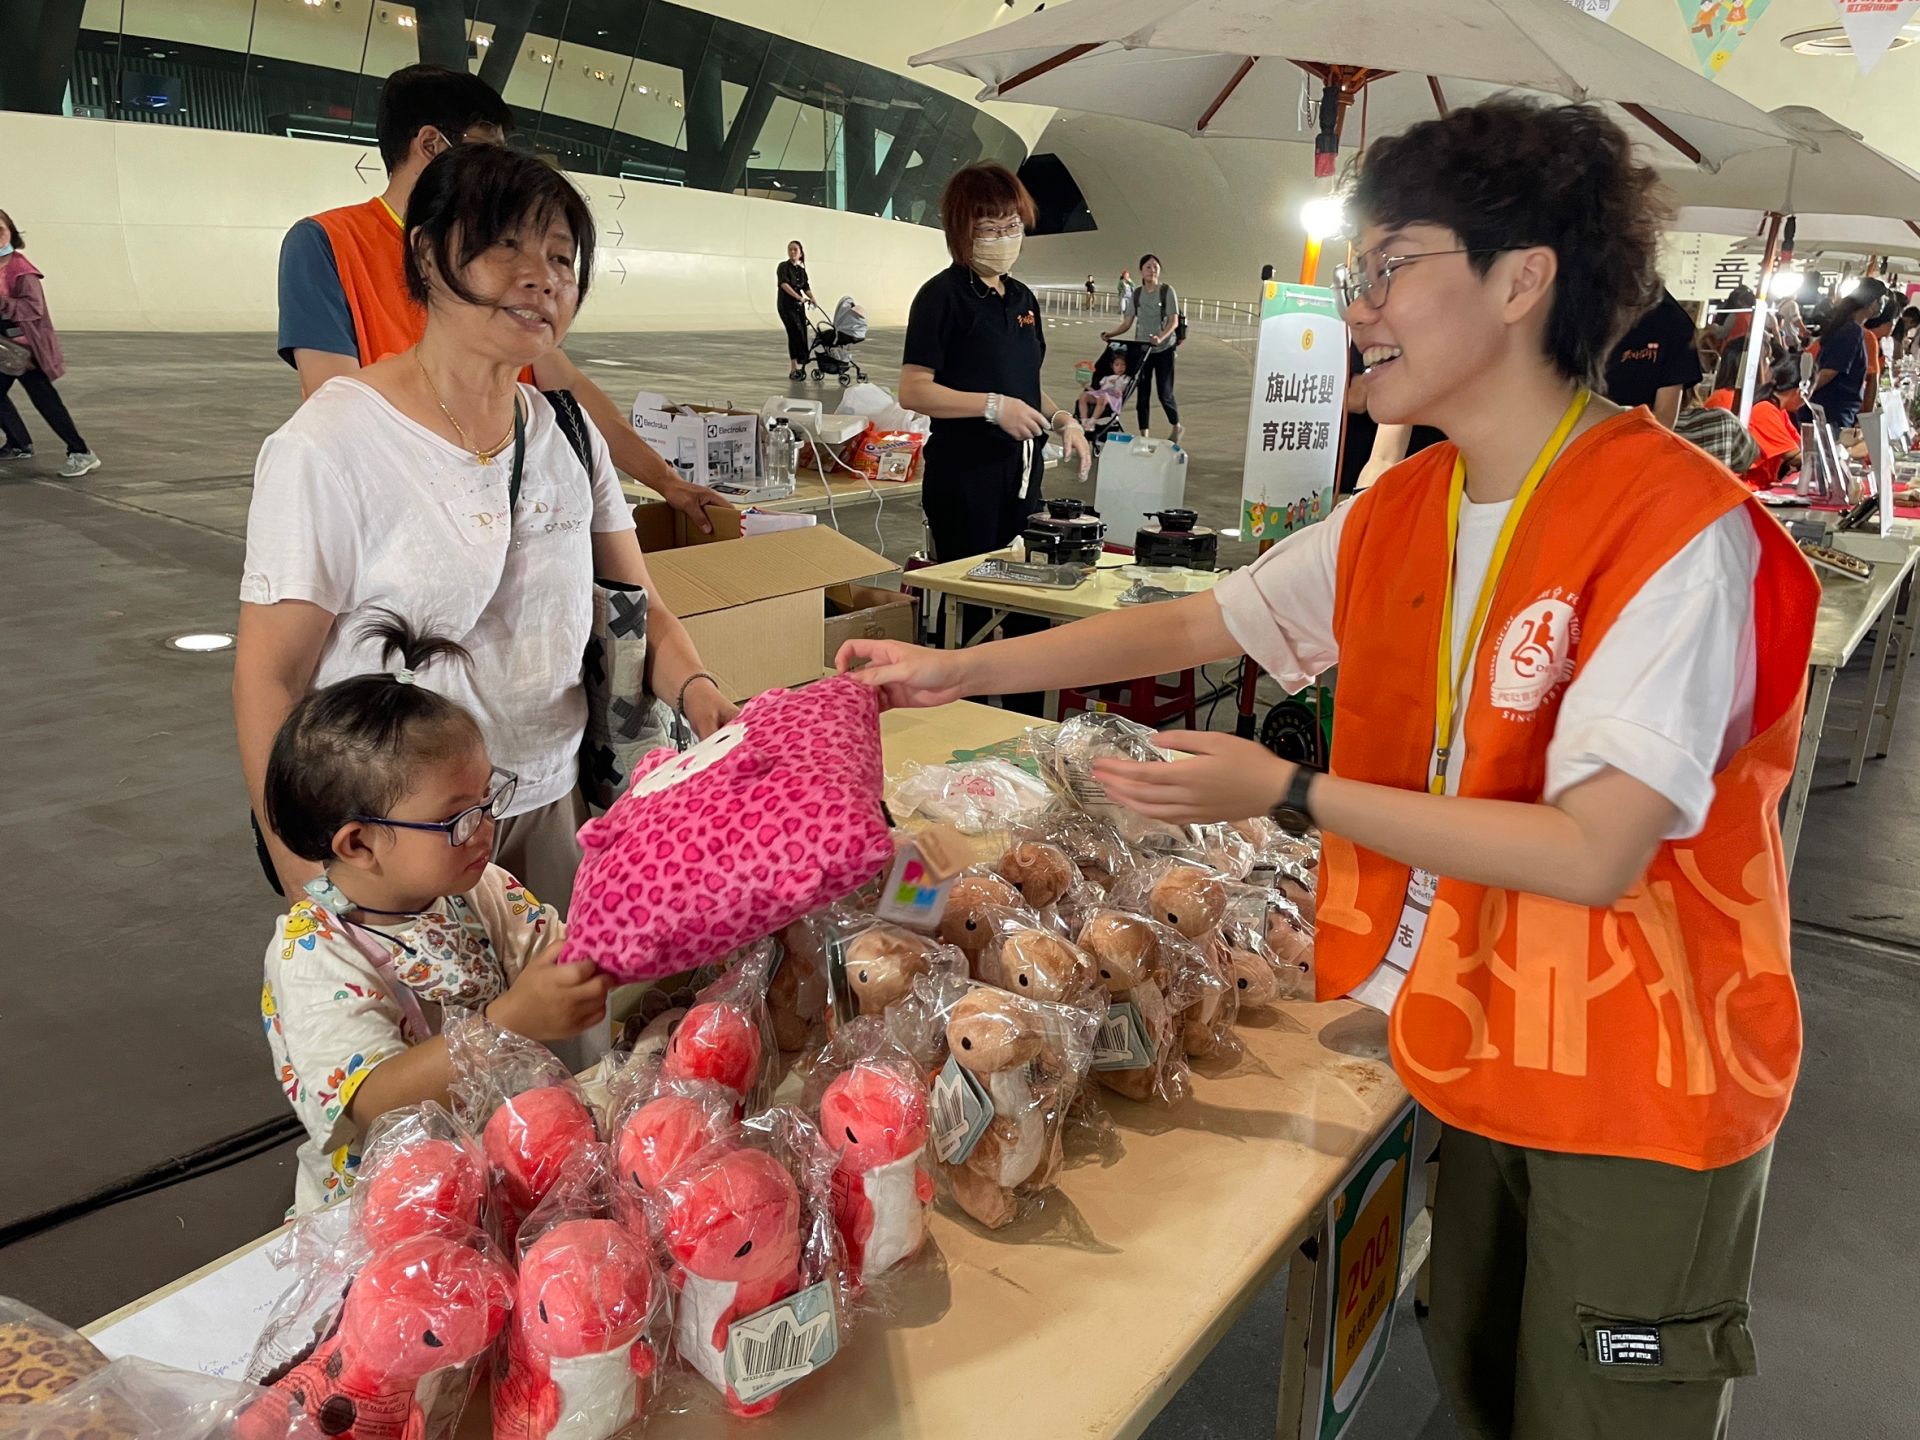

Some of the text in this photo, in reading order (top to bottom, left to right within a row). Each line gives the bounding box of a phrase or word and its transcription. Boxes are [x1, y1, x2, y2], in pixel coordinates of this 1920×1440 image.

[1265, 371, 1335, 404] 旗山托嬰
[719, 426, 747, 435] Electrolux
[1262, 420, 1331, 452] 育兒資源
[1344, 1214, 1390, 1320] 200
[1601, 1332, 1609, 1361] BEST
